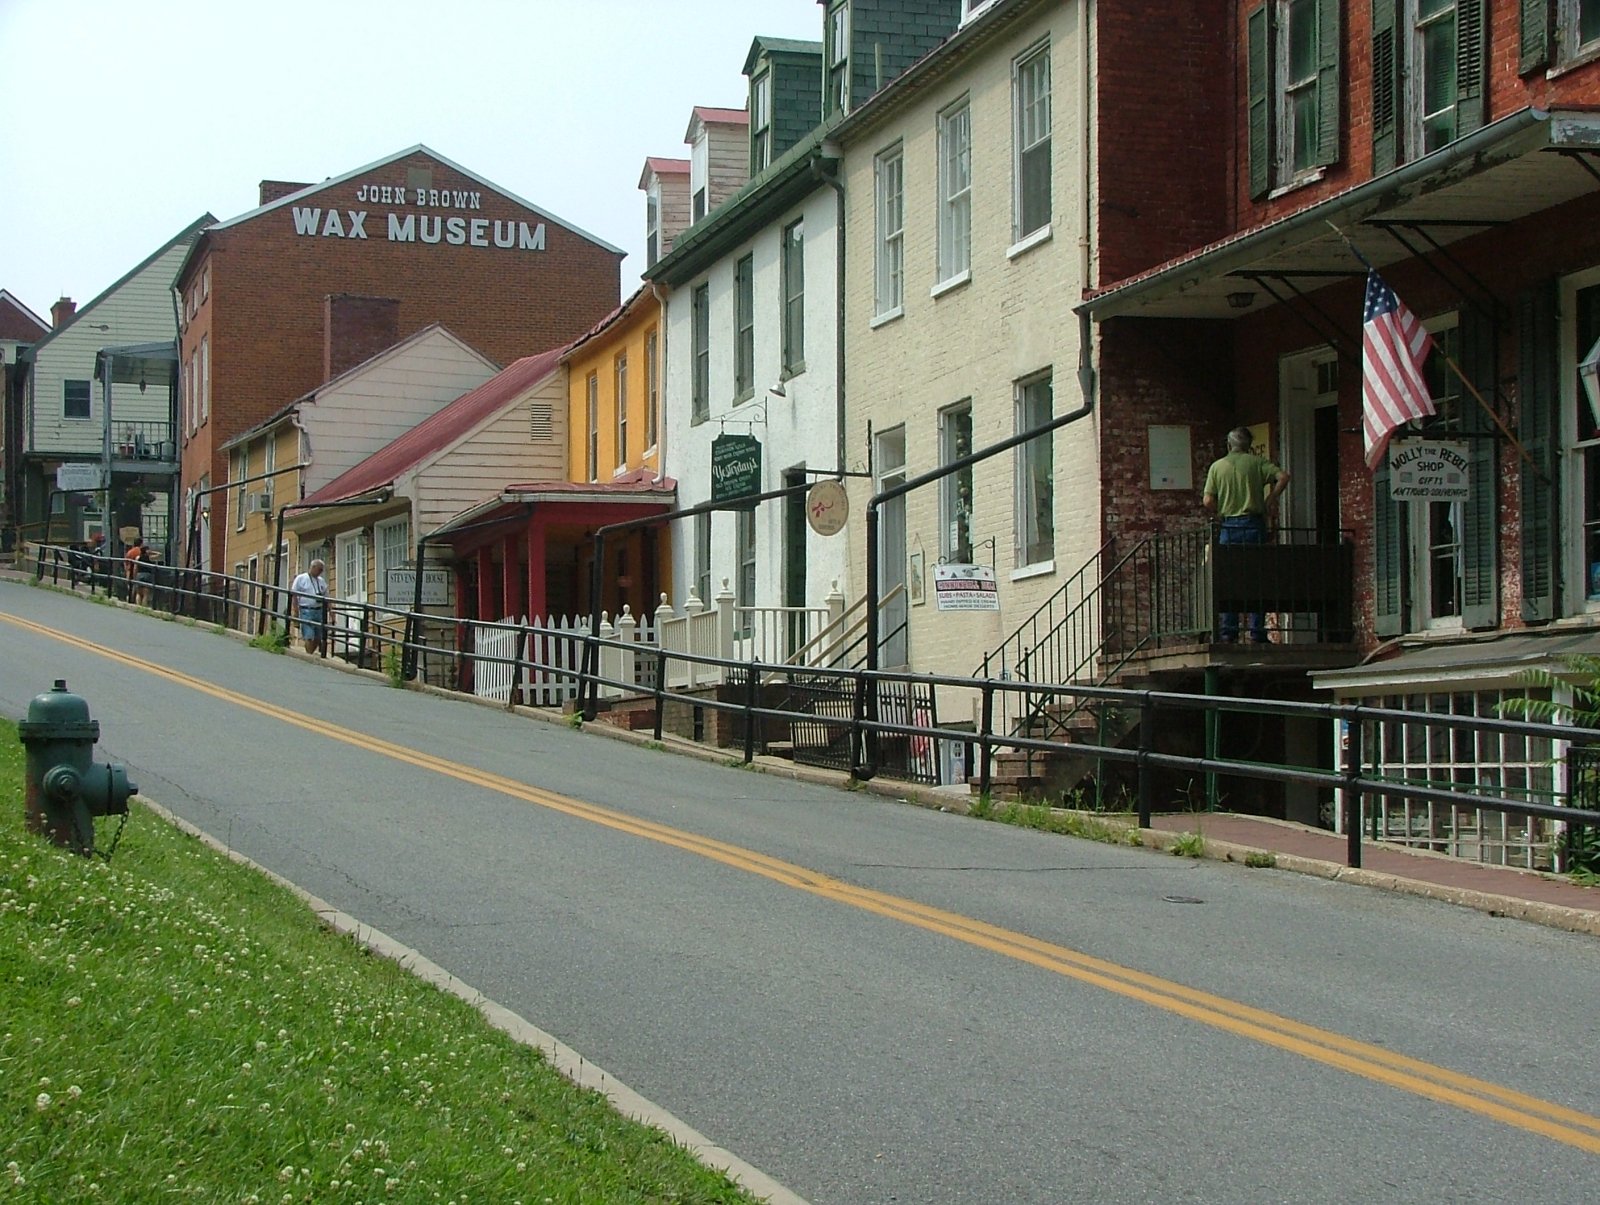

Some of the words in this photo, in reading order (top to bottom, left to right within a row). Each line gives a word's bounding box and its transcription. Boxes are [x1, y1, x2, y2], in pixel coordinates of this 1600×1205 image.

[357, 184, 405, 205] JOHN
[417, 188, 480, 209] BROWN
[292, 207, 368, 239] WAX
[388, 213, 545, 250] MUSEUM
[713, 457, 758, 482] Yesterday's
[1391, 446, 1423, 471] MOLLY
[1439, 447, 1468, 474] REBEL
[1417, 461, 1444, 471] SHOP
[1418, 477, 1443, 485] GIFTS
[390, 573, 416, 583] STEVENS
